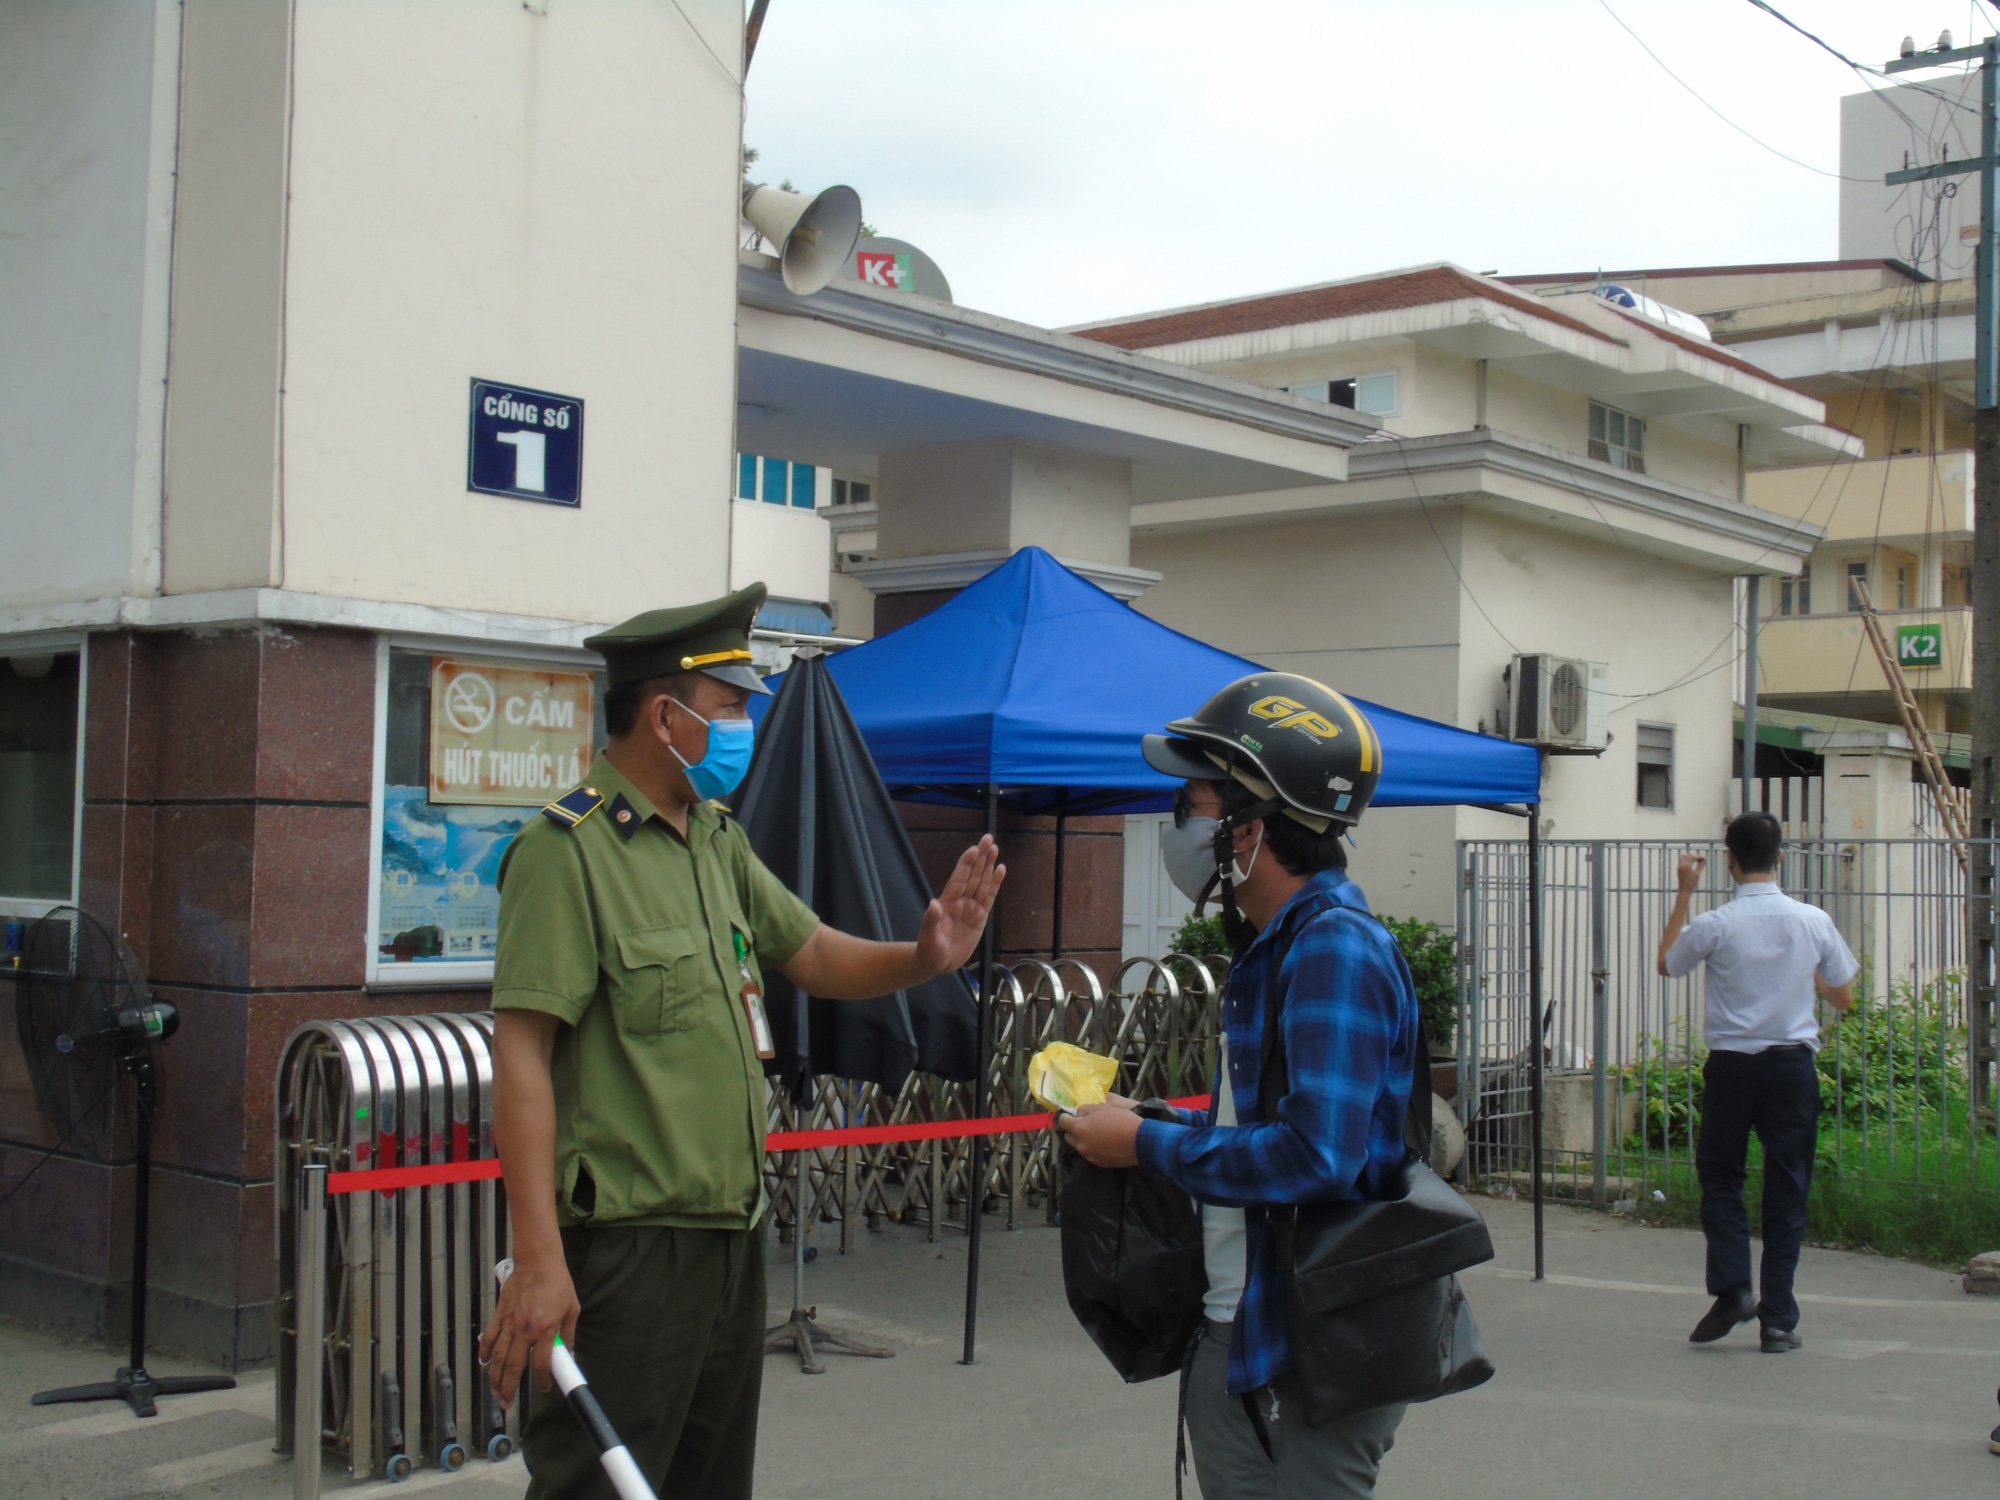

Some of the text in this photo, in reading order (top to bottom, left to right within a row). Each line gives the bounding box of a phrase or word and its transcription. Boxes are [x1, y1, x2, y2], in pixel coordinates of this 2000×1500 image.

[864, 259, 907, 286] K+
[484, 393, 571, 430] CỔNG SỐ
[496, 429, 546, 492] 1
[1901, 635, 1938, 659] K2
[505, 686, 575, 728] CẤM
[1247, 695, 1340, 738] GP
[1293, 725, 1322, 745] EDITION
[444, 740, 581, 789] HÚT THUỐC LÁ
